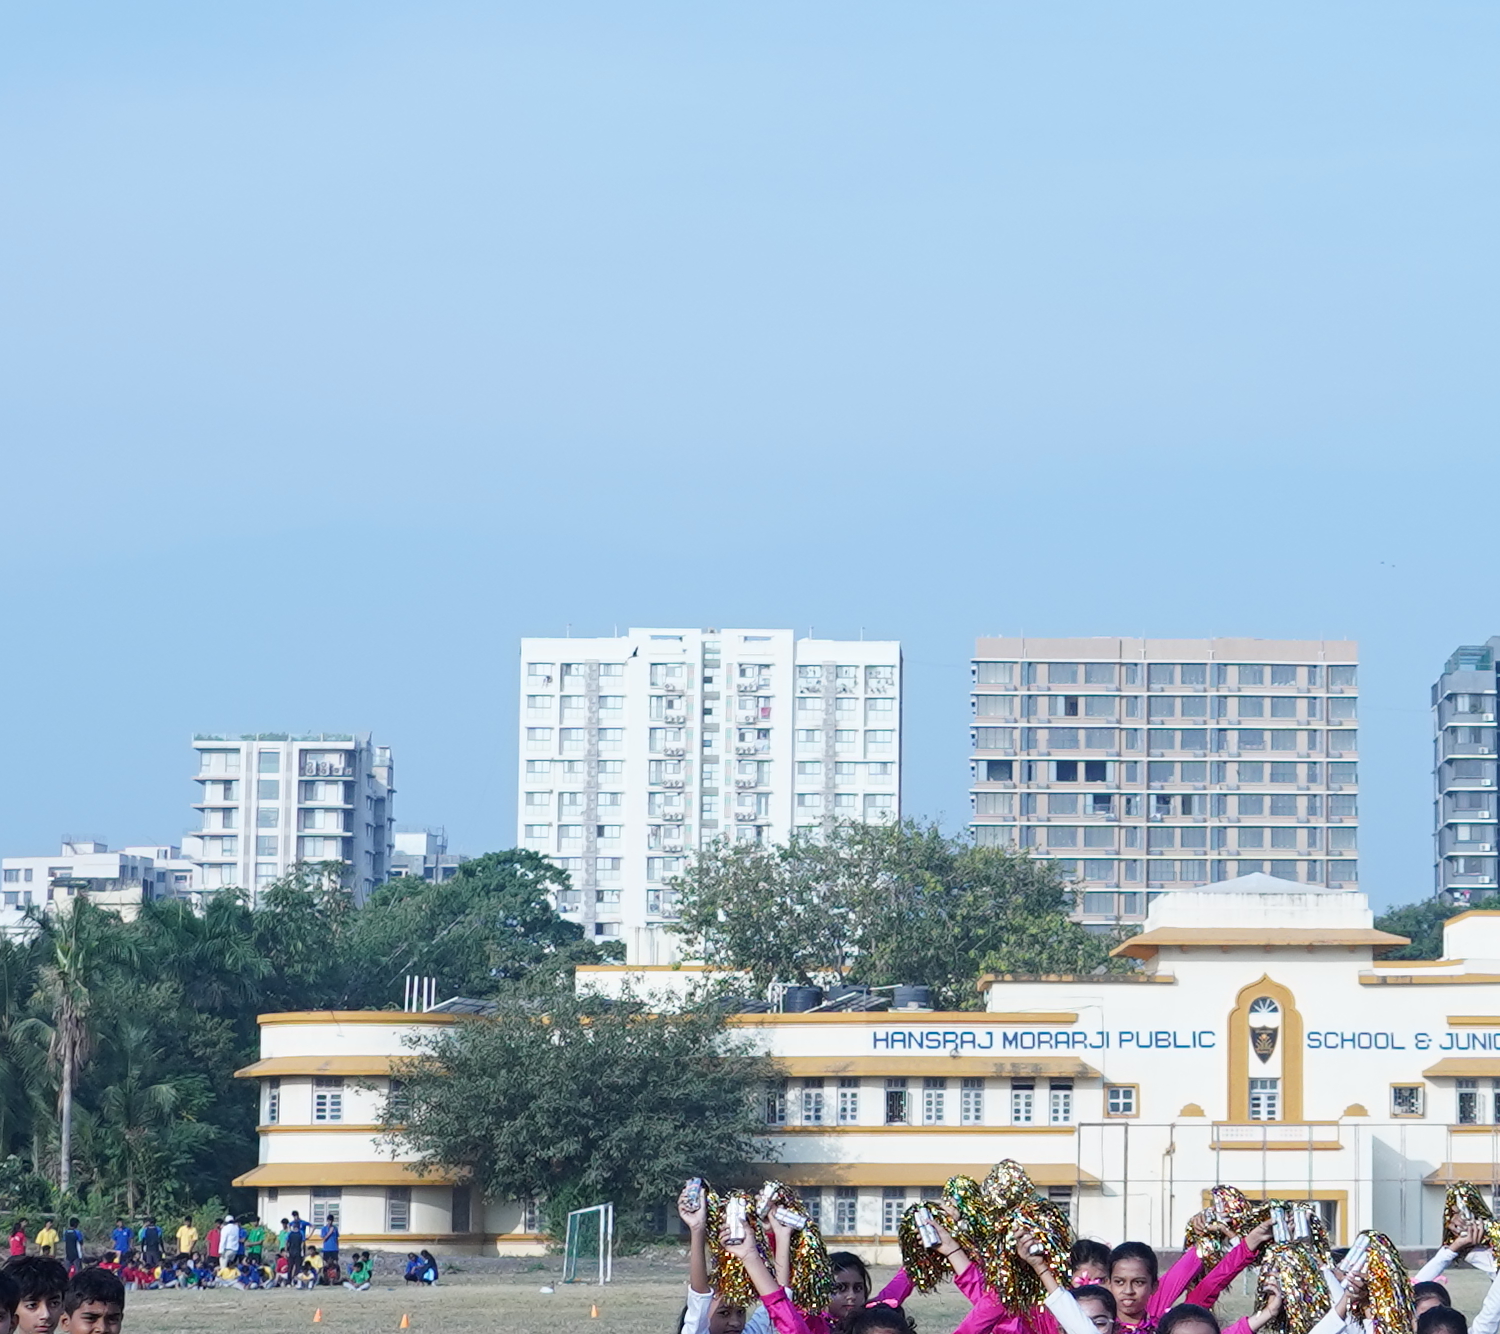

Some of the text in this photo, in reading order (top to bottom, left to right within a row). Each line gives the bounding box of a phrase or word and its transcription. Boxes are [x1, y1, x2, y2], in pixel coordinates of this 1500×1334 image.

[872, 1031, 993, 1049] HANSRAJ
[1003, 1031, 1110, 1049] MORARJI
[1118, 1030, 1216, 1049] PUBLIC
[1306, 1031, 1405, 1050] SCHOOL
[1414, 1033, 1432, 1050] &
